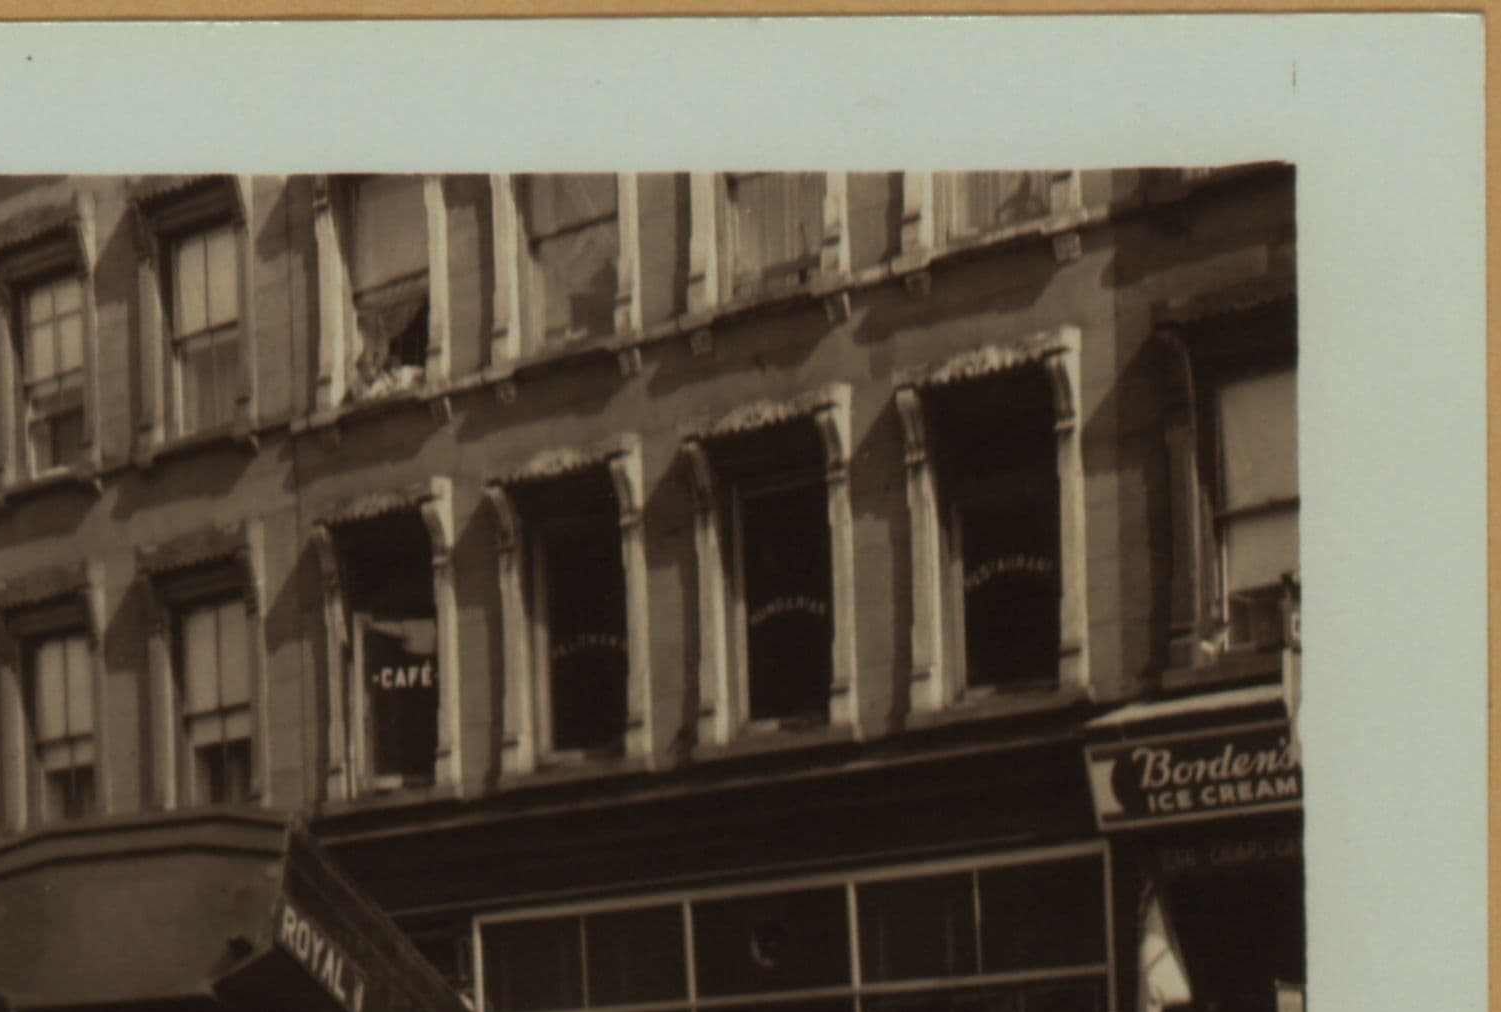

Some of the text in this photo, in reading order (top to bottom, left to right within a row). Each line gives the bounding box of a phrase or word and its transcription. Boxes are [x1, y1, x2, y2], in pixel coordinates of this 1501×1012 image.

[1131, 736, 1297, 790] Borden's
[1148, 776, 1299, 812] ICE CREAM
[281, 903, 347, 1002] ROYAL
